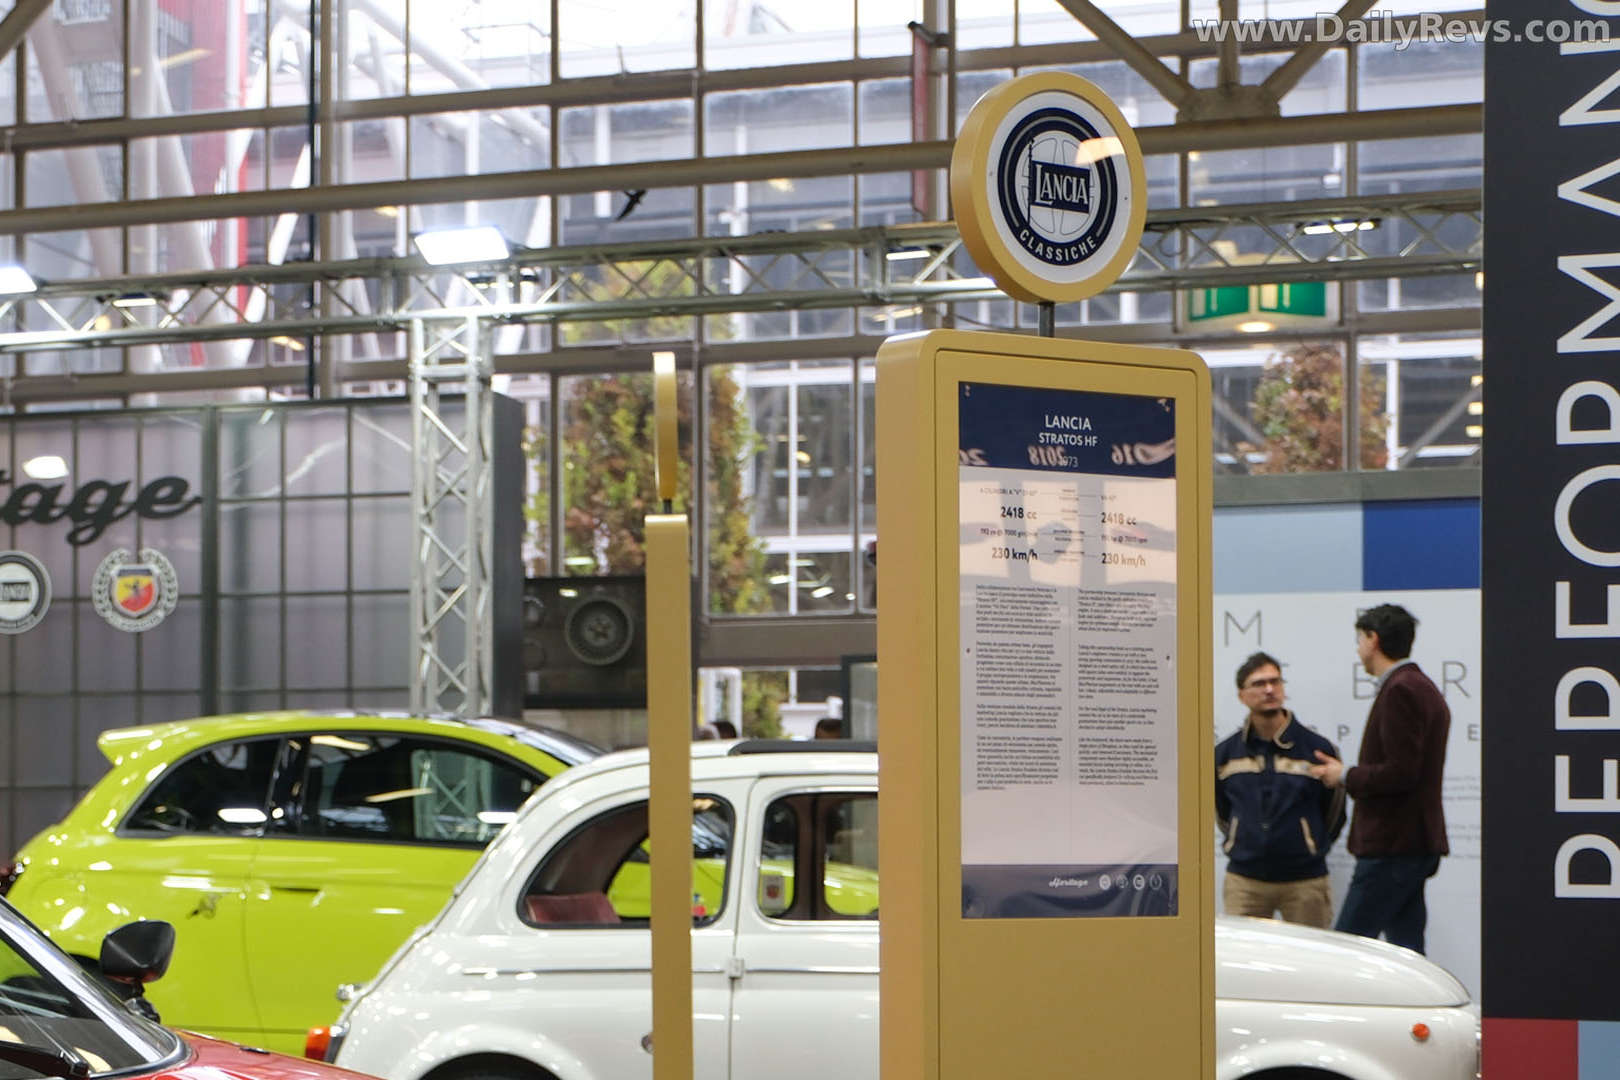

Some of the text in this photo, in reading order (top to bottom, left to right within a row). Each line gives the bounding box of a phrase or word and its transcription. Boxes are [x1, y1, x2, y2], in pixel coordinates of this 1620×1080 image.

[1035, 163, 1089, 206] LANCIA
[1019, 228, 1097, 261] CLASSICHE
[1044, 414, 1092, 431] LANCIA
[1038, 432, 1098, 447] STRATOS HF
[1000, 506, 1037, 520] 2418 cc
[1101, 511, 1137, 526] 2418 cc
[991, 547, 1010, 559] 230
[1012, 547, 1038, 564] km/h
[1101, 552, 1119, 565] 230
[1120, 553, 1146, 568] km/h
[1048, 876, 1089, 889] Heritage
